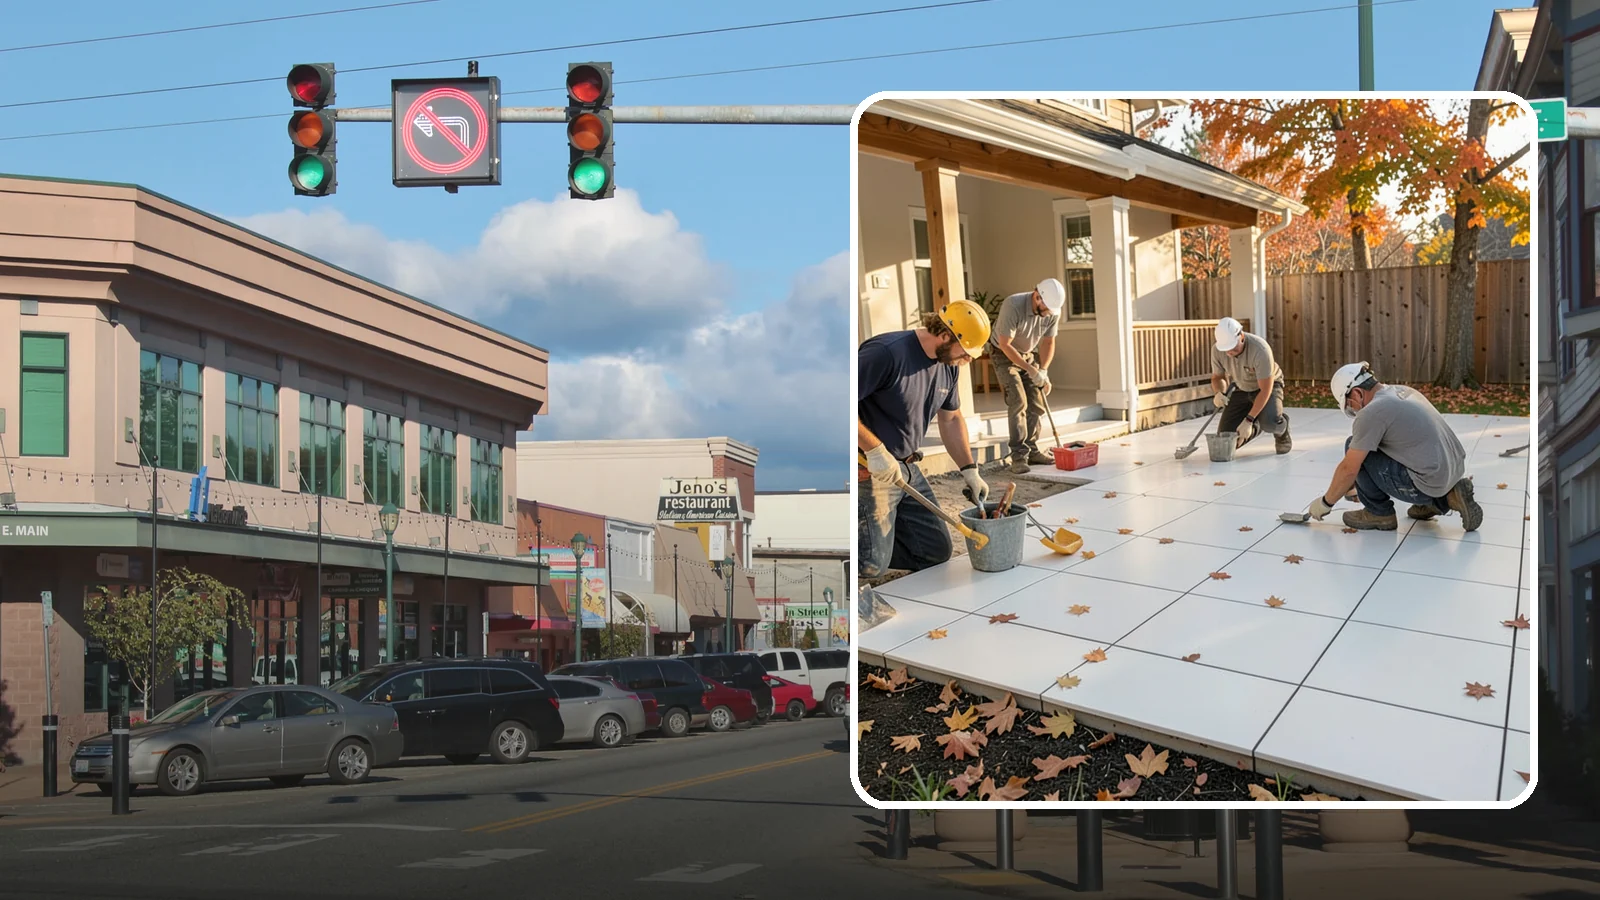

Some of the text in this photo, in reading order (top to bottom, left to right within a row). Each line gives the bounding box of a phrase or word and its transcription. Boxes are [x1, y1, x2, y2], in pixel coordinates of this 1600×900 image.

[670, 480, 727, 494] Jeno's
[665, 497, 731, 509] restaurant
[659, 510, 681, 519] Italian
[686, 510, 714, 519] American
[715, 509, 738, 519] Cuisine
[2, 525, 49, 536] E. MAIN
[798, 608, 828, 617] Street
